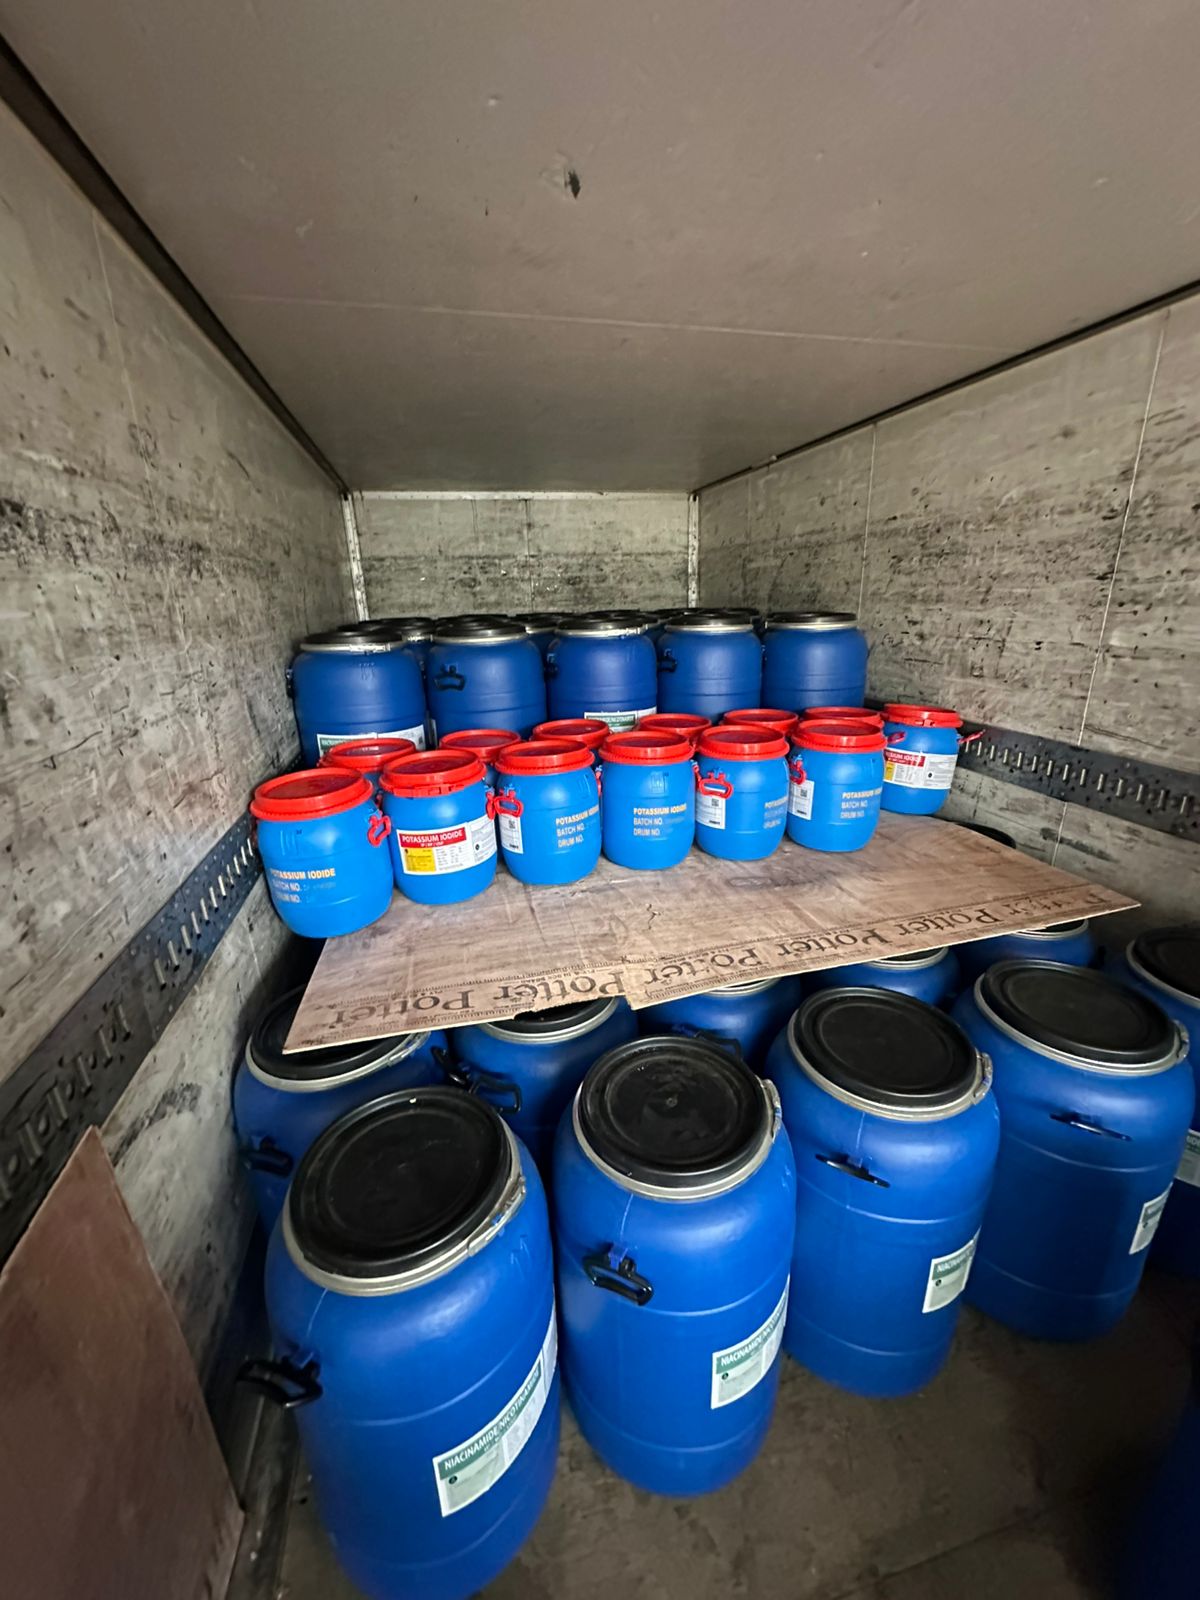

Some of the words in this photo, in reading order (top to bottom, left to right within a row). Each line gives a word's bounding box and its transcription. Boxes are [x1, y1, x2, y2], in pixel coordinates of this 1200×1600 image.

[555, 810, 588, 826] POTASSIUM
[634, 807, 670, 816] POTASSIUM
[634, 817, 652, 826] BATCH
[402, 834, 439, 843] POTASSIUM
[440, 830, 463, 841] IODIDE
[556, 825, 576, 837] BATCH
[634, 828, 651, 836] DRUM
[557, 837, 575, 848] DRUM
[307, 868, 336, 880] IODIDE
[894, 908, 1003, 936] Potter
[775, 928, 892, 957] Potter
[493, 971, 625, 1001] Potter
[329, 990, 475, 1029] Potter
[444, 1425, 499, 1471] NIACINAMIDE
